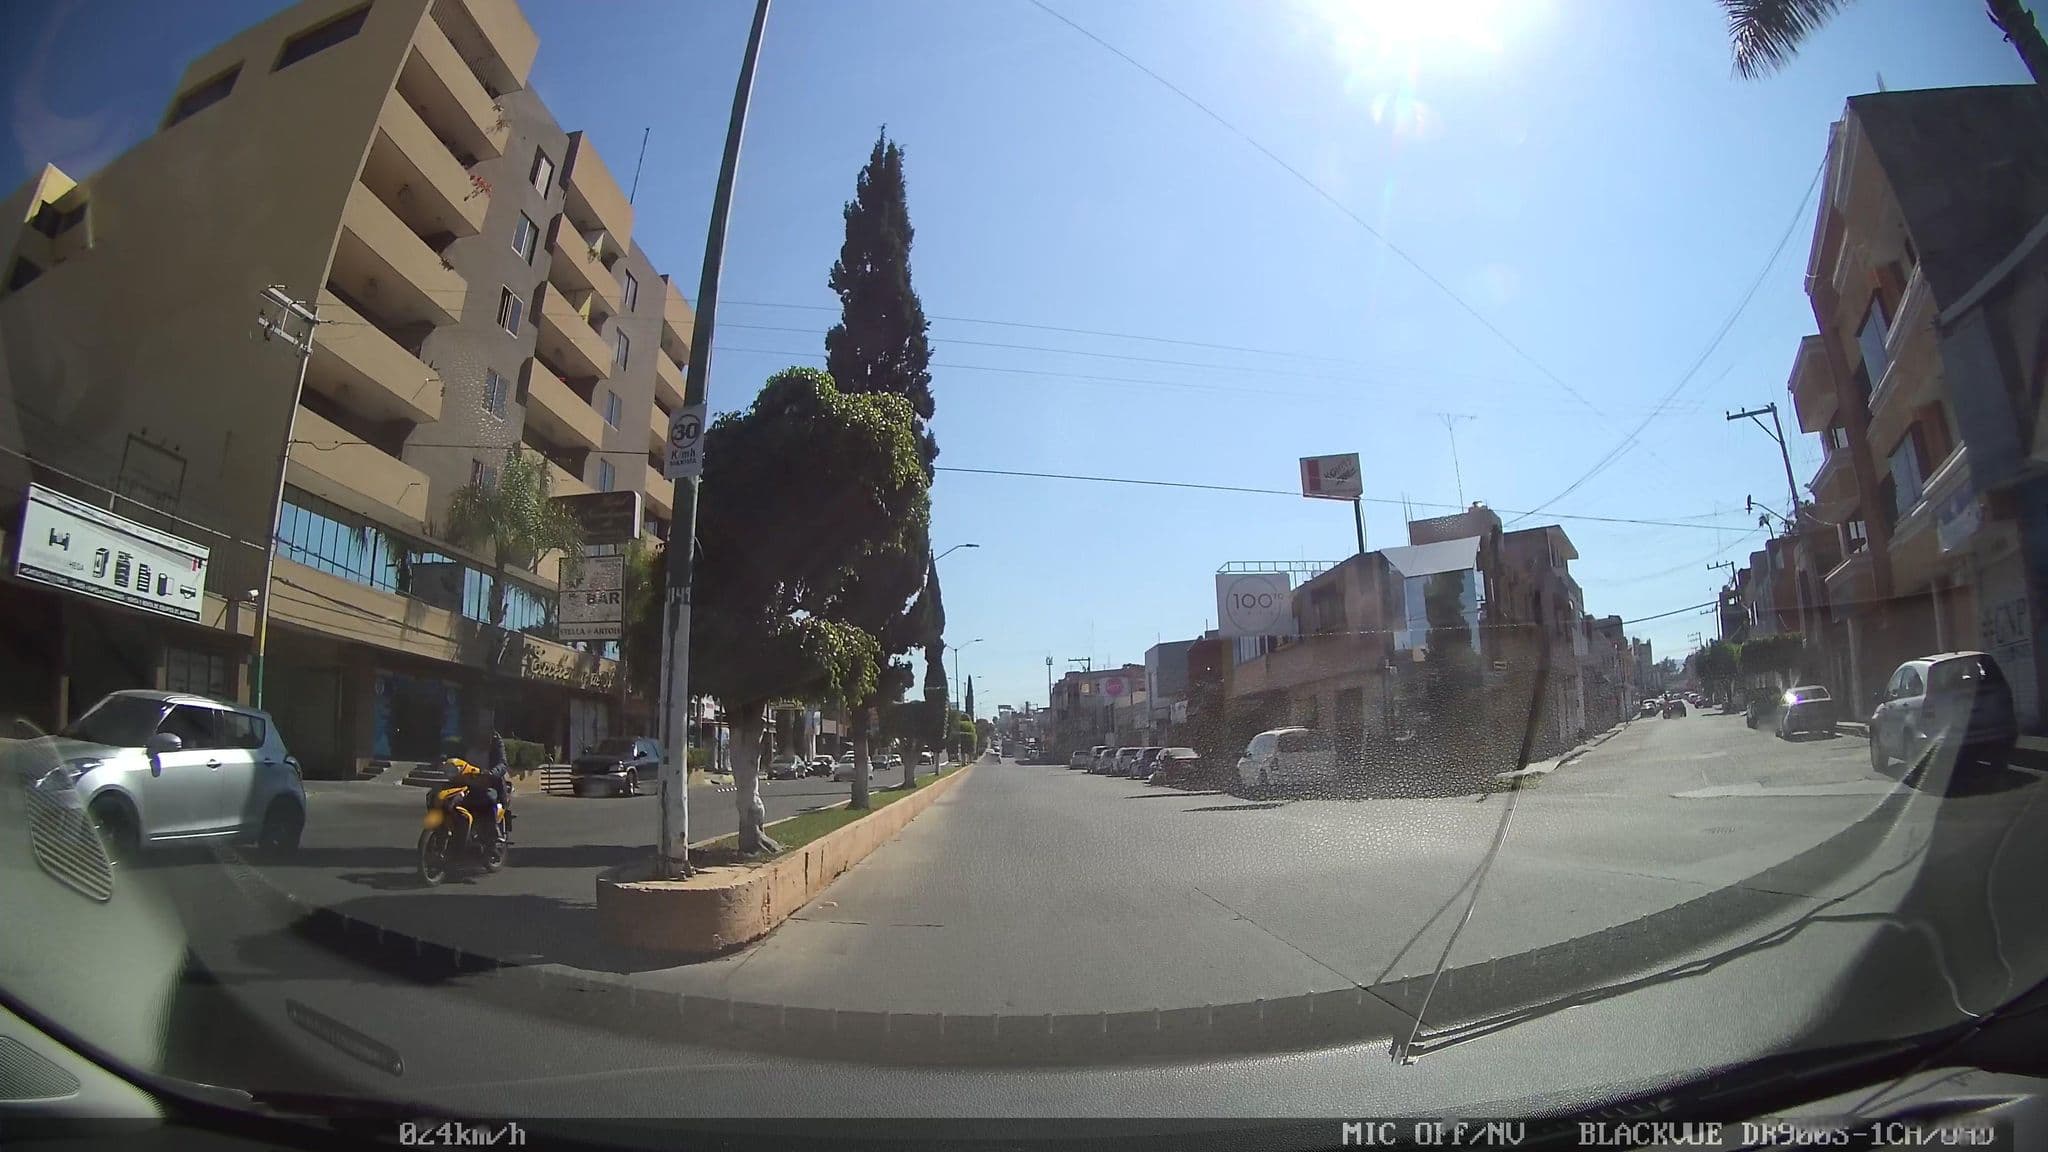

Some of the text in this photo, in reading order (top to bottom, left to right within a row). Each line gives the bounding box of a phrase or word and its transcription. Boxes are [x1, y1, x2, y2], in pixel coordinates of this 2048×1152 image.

[672, 423, 699, 440] 30
[585, 591, 620, 605] BAR
[1233, 593, 1273, 609] 100
